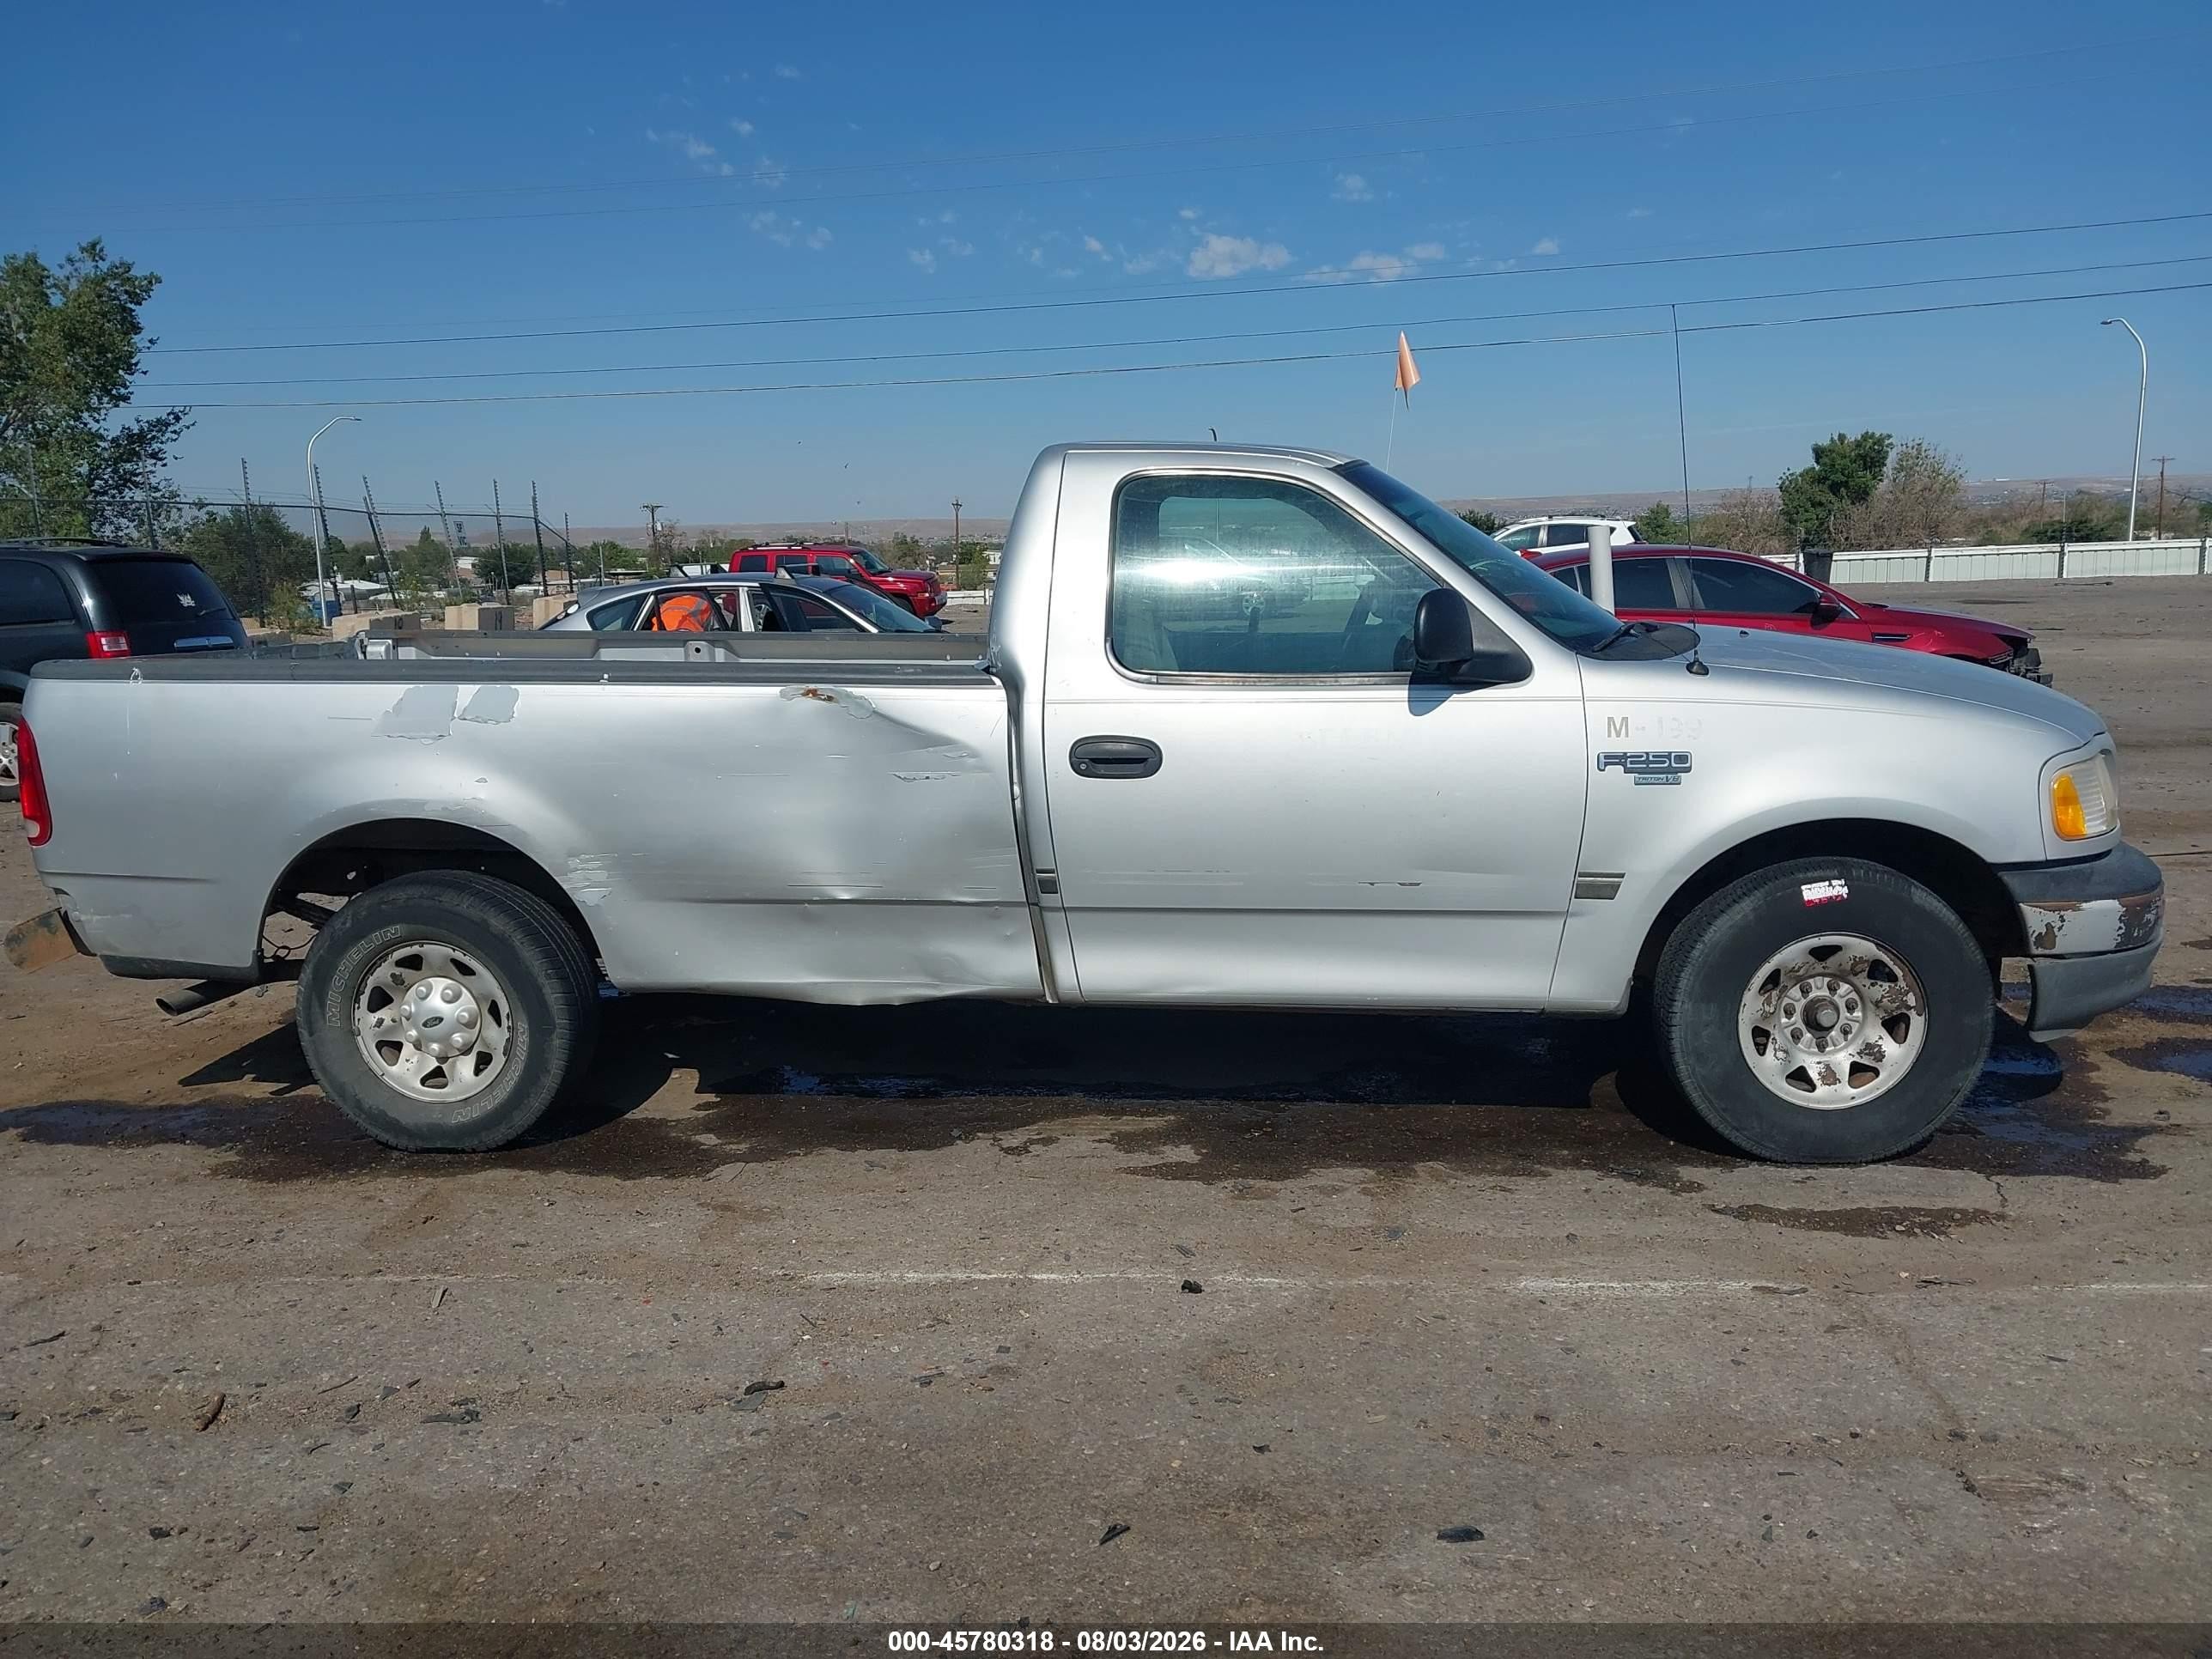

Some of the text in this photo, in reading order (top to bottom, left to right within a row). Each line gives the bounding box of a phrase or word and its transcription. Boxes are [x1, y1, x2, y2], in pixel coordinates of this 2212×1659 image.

[1665, 775, 1680, 783] V8
[326, 926, 402, 1027] MICHELIN
[452, 1022, 530, 1123] MICHELIN
